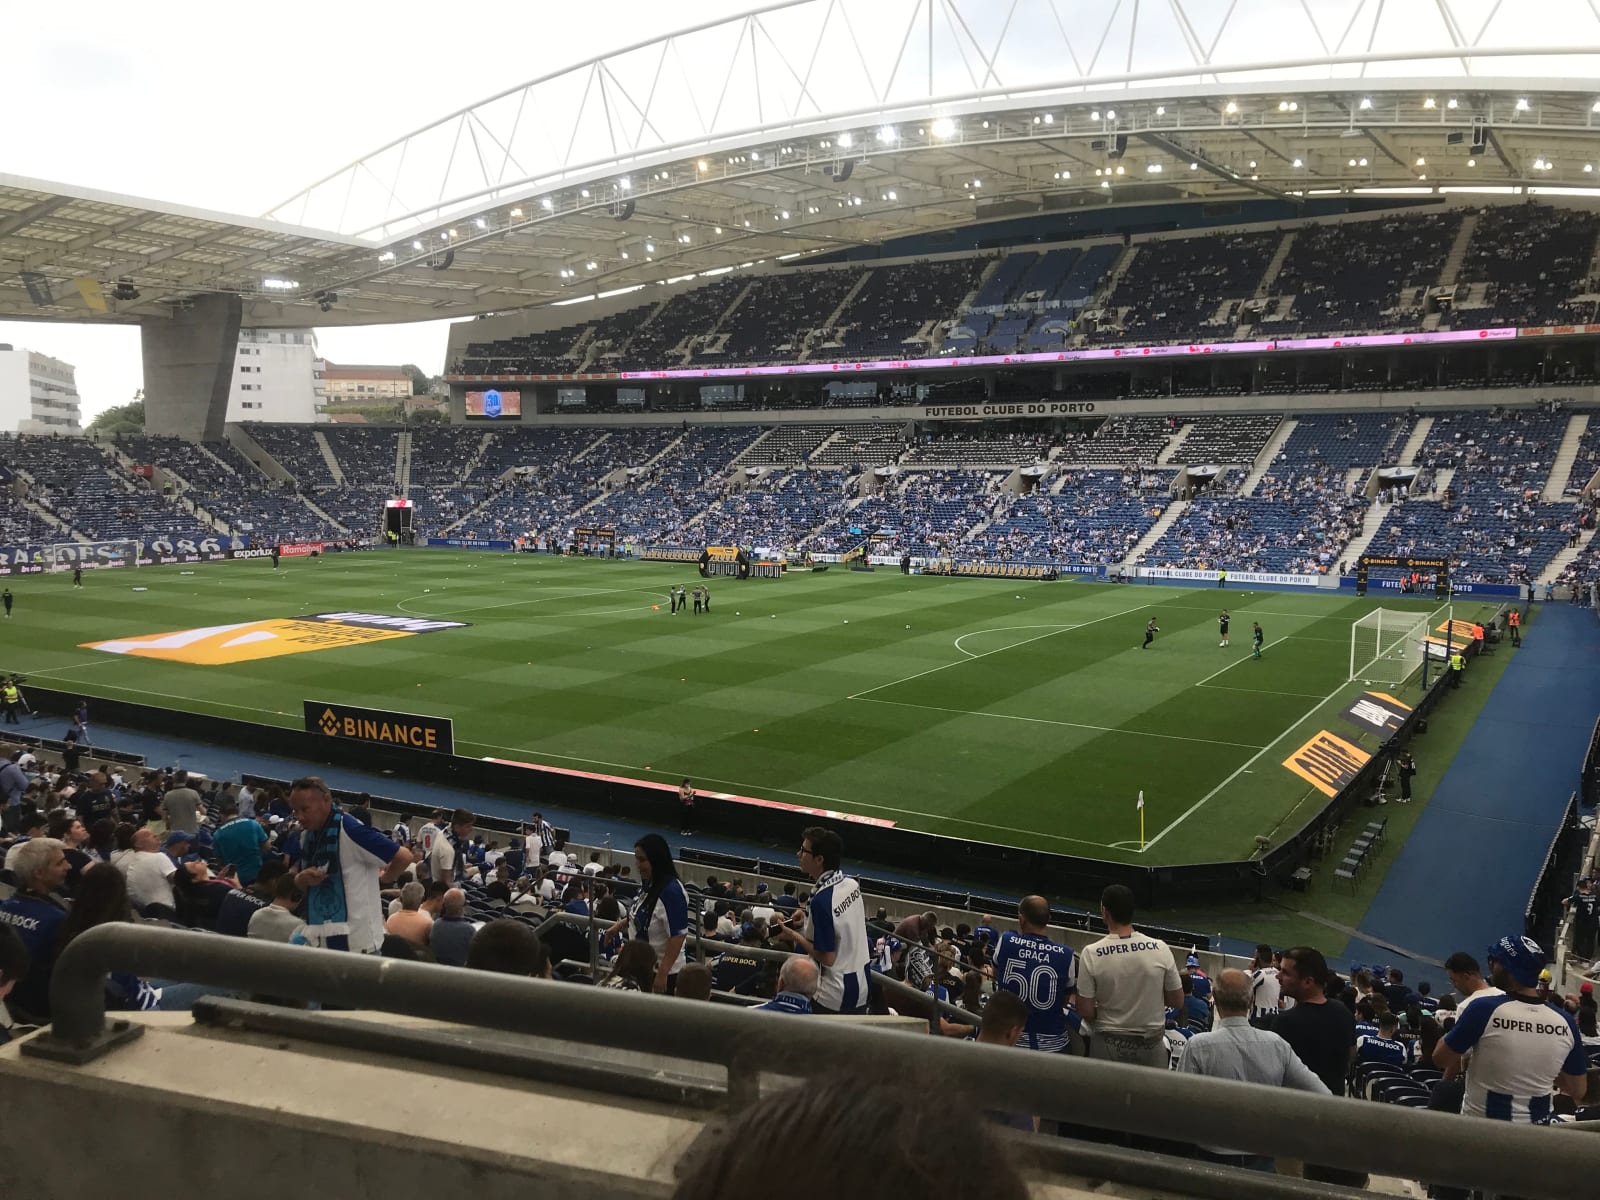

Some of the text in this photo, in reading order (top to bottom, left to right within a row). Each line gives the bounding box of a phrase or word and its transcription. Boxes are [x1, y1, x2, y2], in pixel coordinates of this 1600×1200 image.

[925, 402, 1095, 417] FUTEBOL CLUBE DO PORTO
[1230, 573, 1310, 584] FUTEBOL CLUBE DO PORTO
[343, 716, 438, 748] BINANCE
[834, 896, 853, 917] SUPER
[11, 914, 40, 930] BOCK
[1009, 936, 1065, 954] SUPER BOCK
[1096, 941, 1160, 957] SUPER BOCK
[739, 958, 757, 967] BOCK
[1018, 948, 1050, 964] GRAÇA
[1002, 957, 1059, 1010] 50
[1492, 1017, 1569, 1036] SUPER BOCK
[1367, 1038, 1401, 1051] SUPER BOCK
